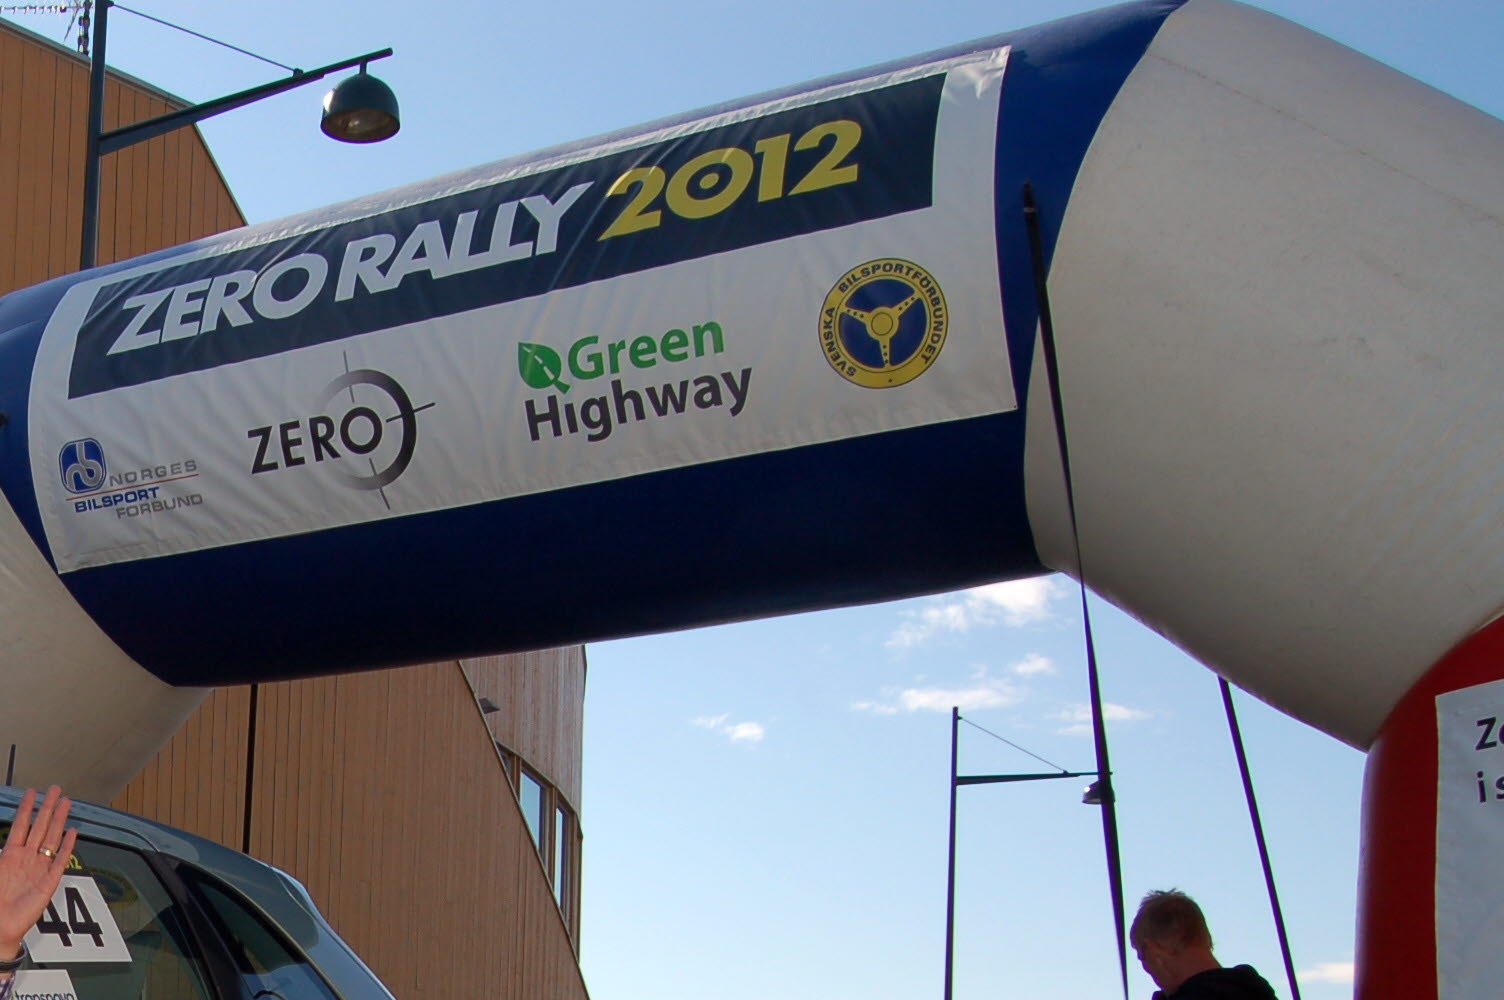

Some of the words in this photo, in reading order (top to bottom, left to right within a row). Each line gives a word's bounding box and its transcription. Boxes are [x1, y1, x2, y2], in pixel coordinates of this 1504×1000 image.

[106, 252, 329, 356] ZERO
[334, 181, 595, 302] RALLY
[597, 119, 863, 242] 2012
[567, 321, 724, 380] Green
[823, 307, 857, 377] SVENSKA
[525, 367, 752, 442] Highway
[247, 406, 383, 475] ZERO
[74, 486, 161, 513] BILSPORT
[109, 459, 198, 487] NORGES
[116, 493, 204, 519] FORBUND
[1475, 716, 1504, 751] Z
[36, 887, 104, 947] 44
